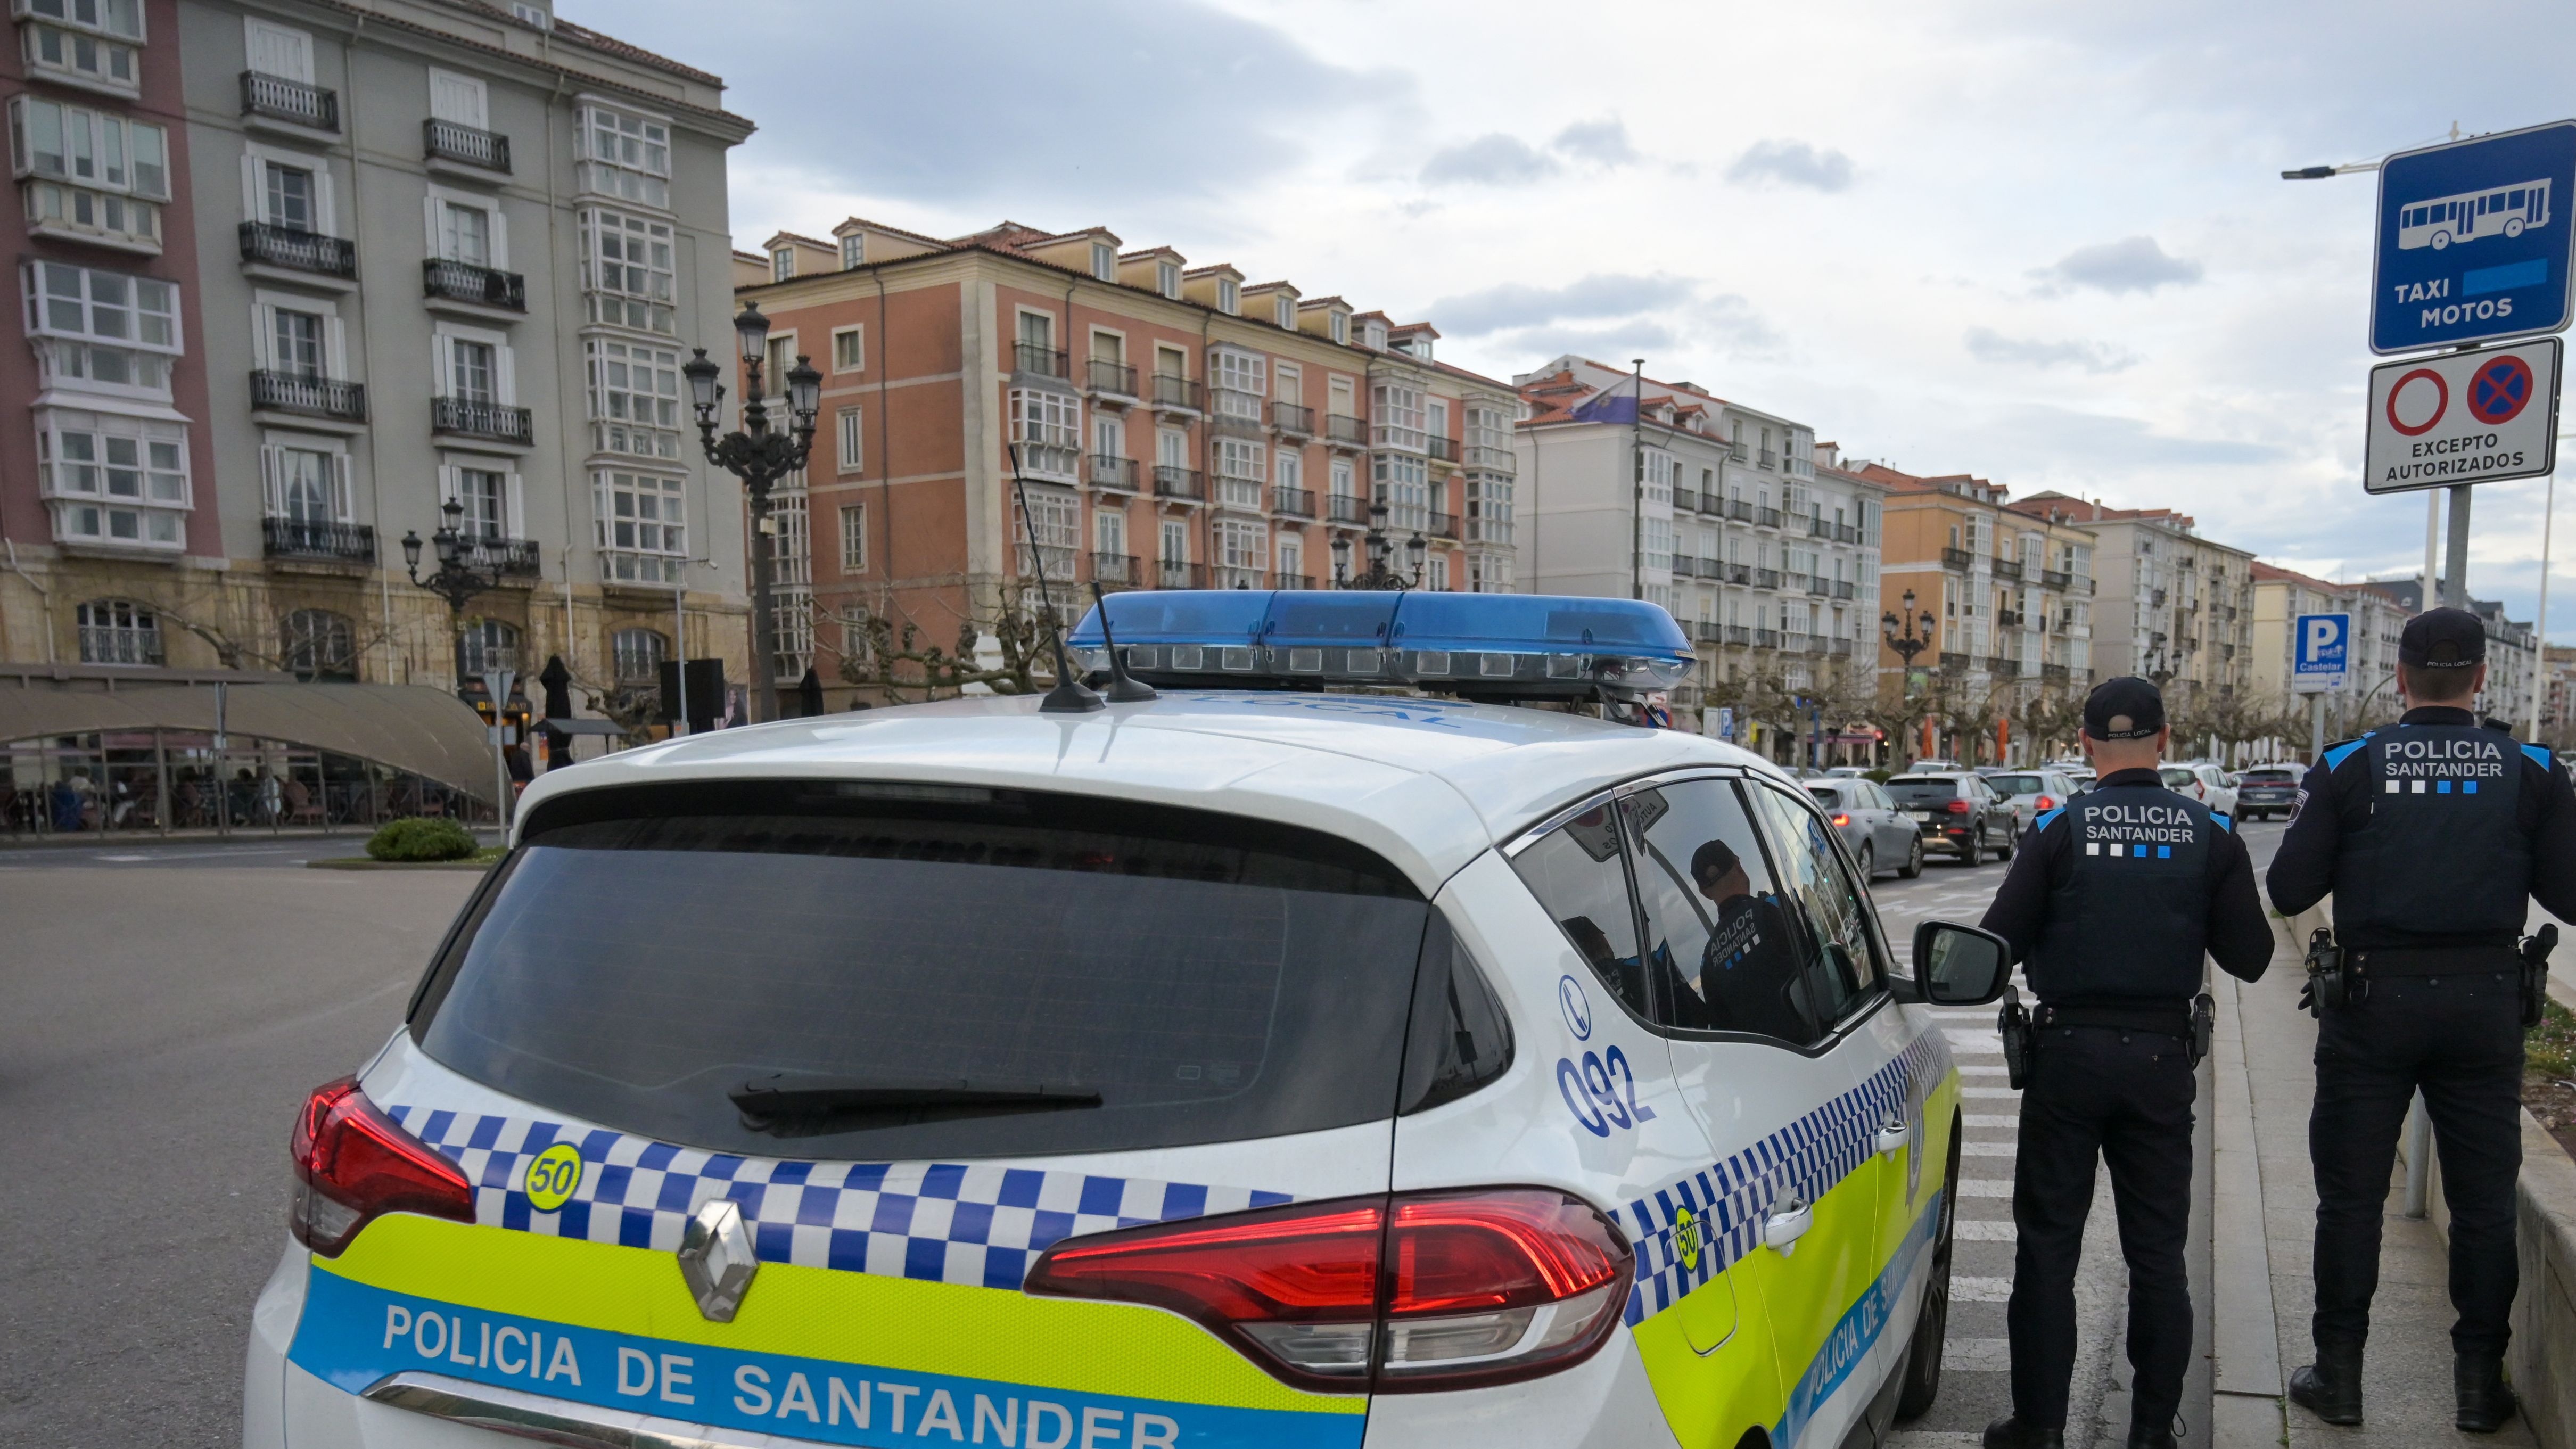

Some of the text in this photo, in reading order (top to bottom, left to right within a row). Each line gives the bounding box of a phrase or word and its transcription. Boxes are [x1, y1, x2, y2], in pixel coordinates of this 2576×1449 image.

[2394, 278, 2449, 304] TAXI
[2421, 298, 2513, 328] MOTOS
[2412, 432, 2498, 458] EXCEPTO
[2385, 451, 2524, 482] AUTORIZADOS
[2306, 619, 2339, 662] P
[2299, 662, 2342, 672] Castelar
[1190, 696, 1462, 729] LOCAL
[2133, 728, 2151, 737] LOCAL
[2384, 739, 2503, 760] POLICIA
[2385, 762, 2503, 777] SANTANDER
[2084, 805, 2194, 826] POLICIA
[2086, 825, 2194, 843] SANTANDER
[1556, 1044, 1657, 1138] 092
[531, 1157, 575, 1196] 50
[1678, 1220, 1696, 1257] 50
[1808, 1316, 1858, 1408] POLICIA
[1863, 1290, 1879, 1338] DE
[383, 1304, 1179, 1449] POLICIA DE SANTANDER
